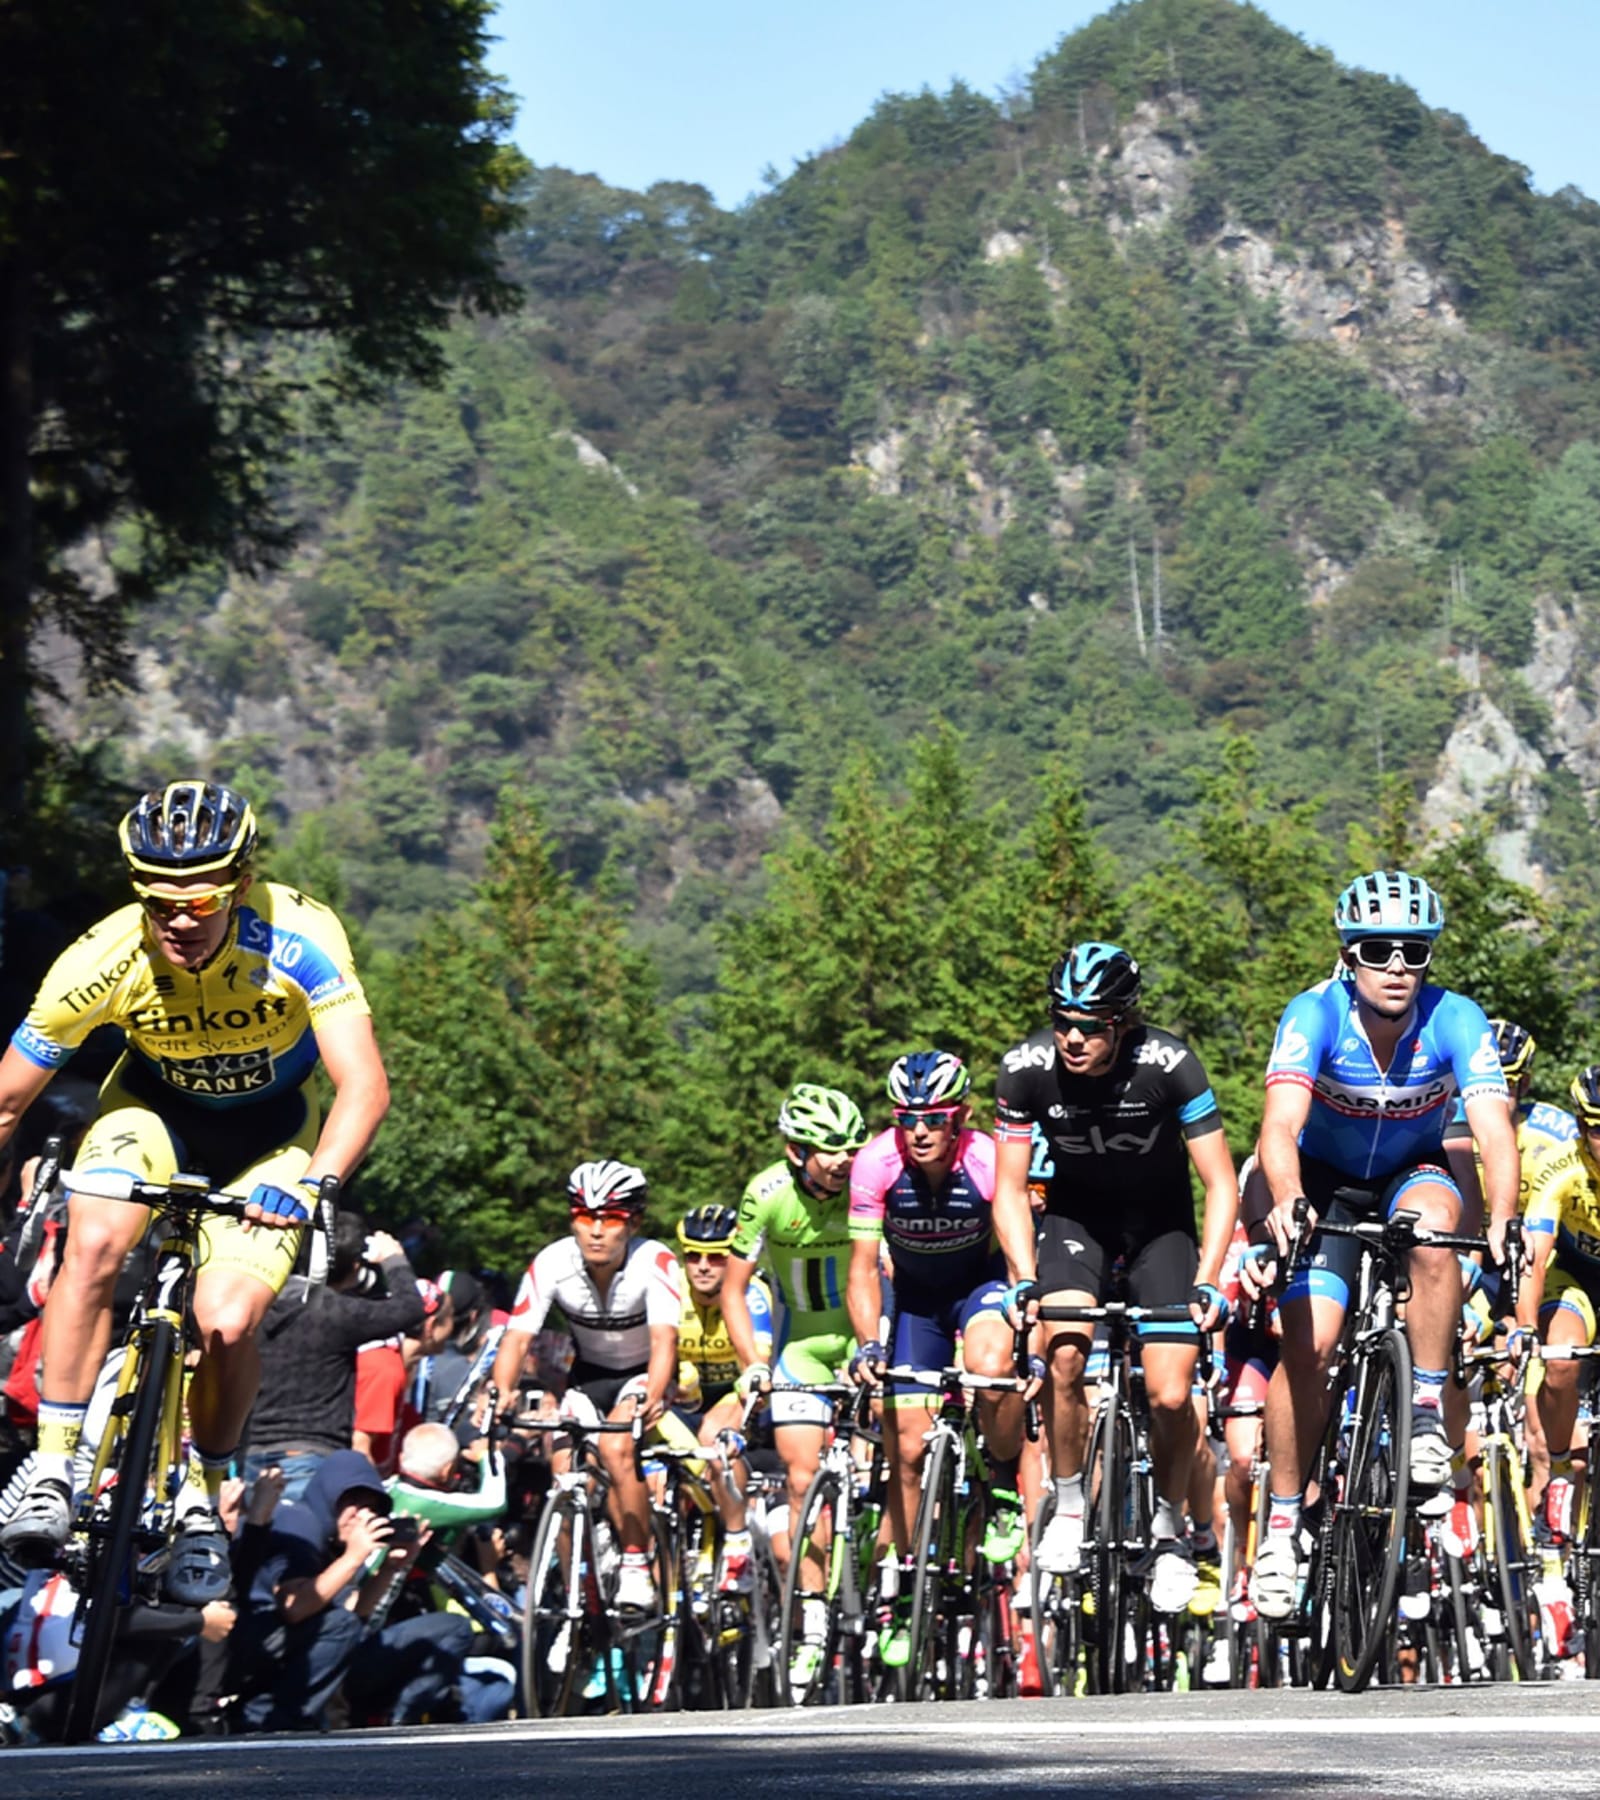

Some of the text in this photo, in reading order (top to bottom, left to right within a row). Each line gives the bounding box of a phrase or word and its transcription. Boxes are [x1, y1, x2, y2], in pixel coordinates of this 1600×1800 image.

[248, 918, 303, 968] SXO
[128, 998, 288, 1032] Tinkoff
[1003, 1043, 1056, 1073] sky
[1132, 1039, 1187, 1073] sky
[171, 1070, 264, 1092] BANK
[1054, 1122, 1163, 1154] sky
